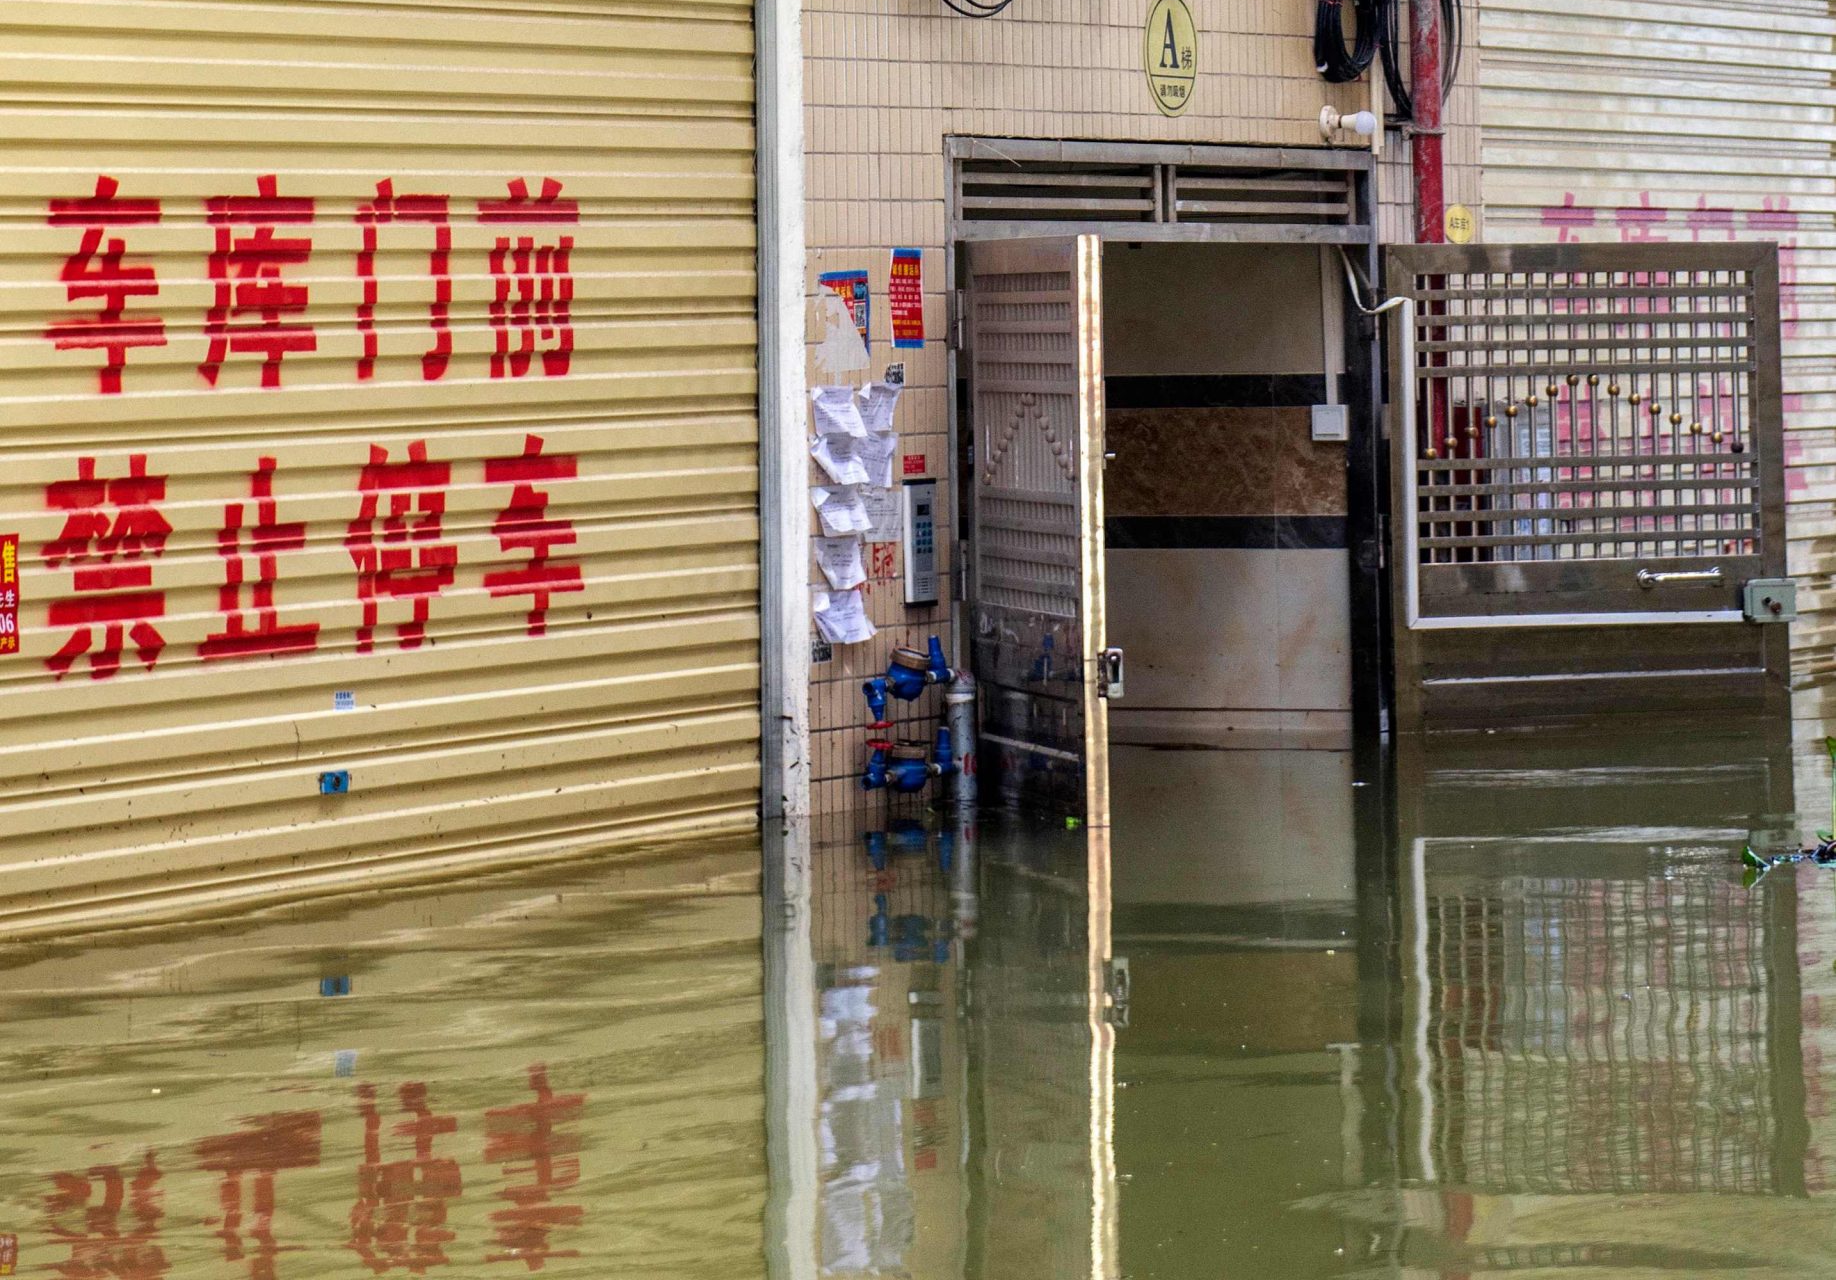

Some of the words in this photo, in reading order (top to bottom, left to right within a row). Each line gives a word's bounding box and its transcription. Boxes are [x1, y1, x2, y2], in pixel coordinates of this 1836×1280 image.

[1160, 84, 1185, 98] 请勿吸烟
[46, 174, 580, 394] 车库门前
[40, 434, 586, 681] 禁止停车
